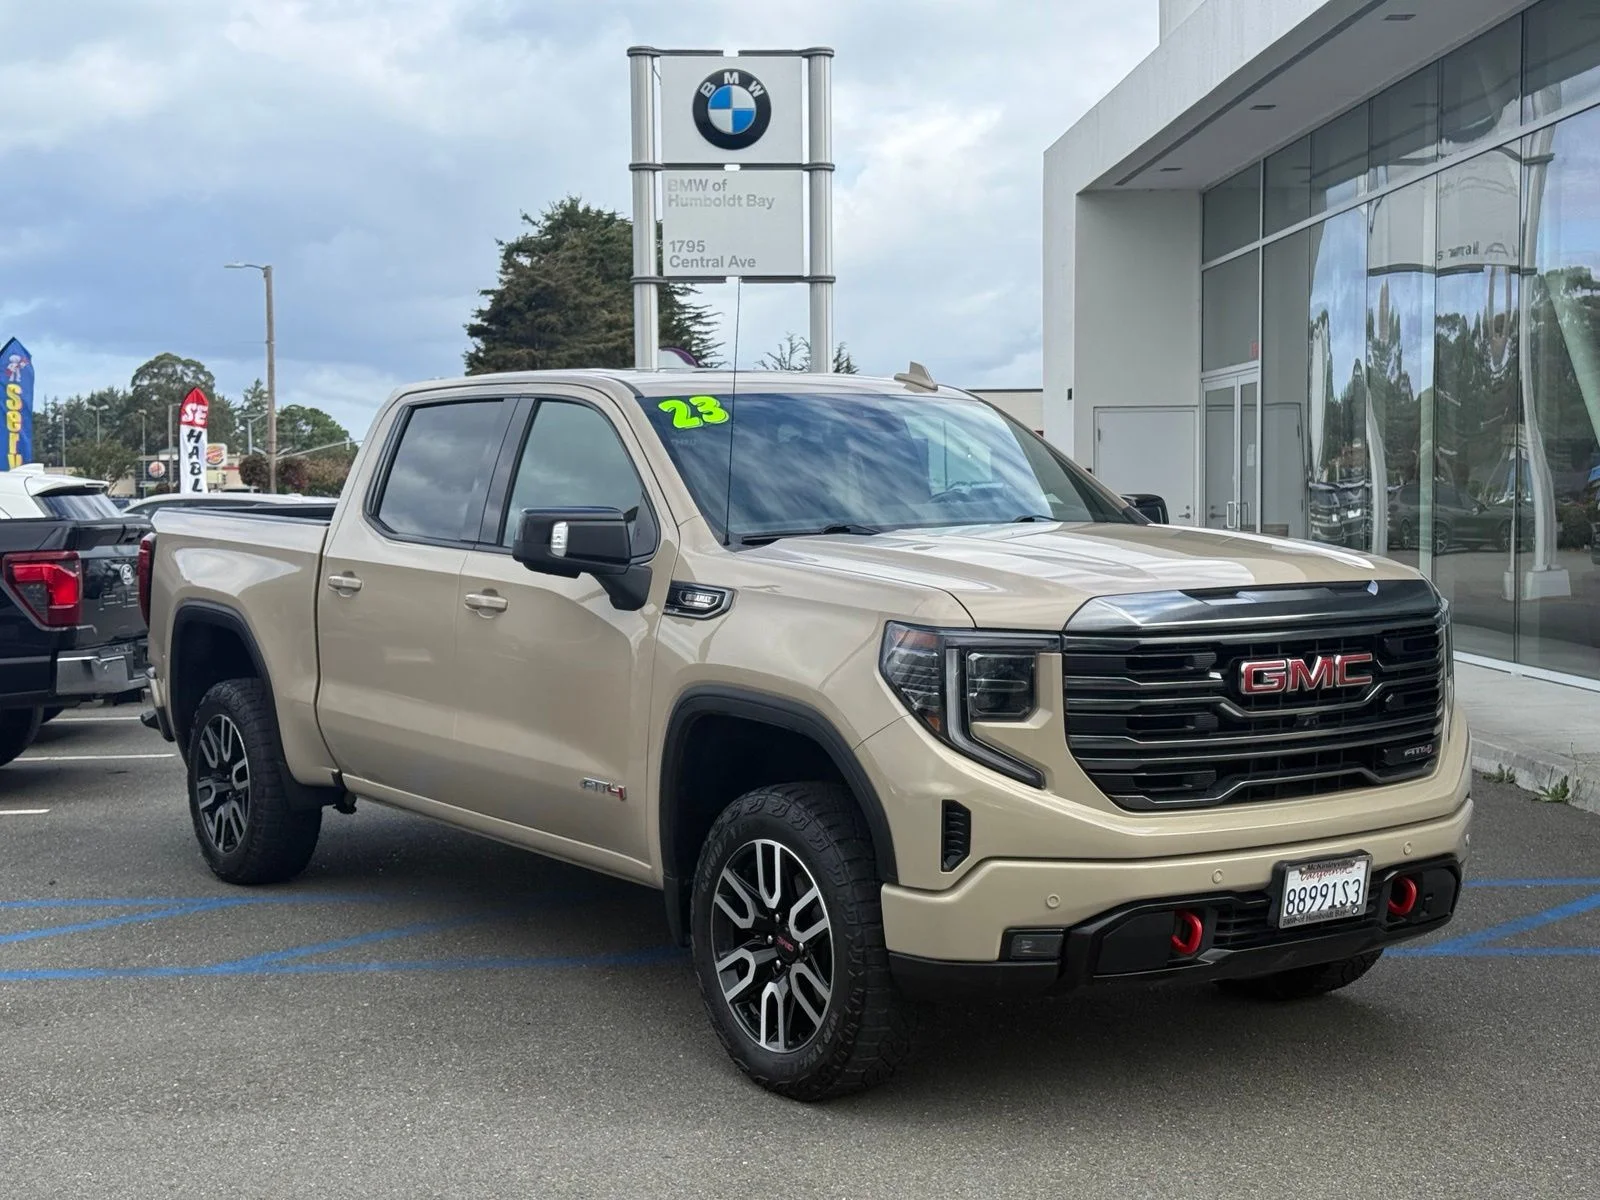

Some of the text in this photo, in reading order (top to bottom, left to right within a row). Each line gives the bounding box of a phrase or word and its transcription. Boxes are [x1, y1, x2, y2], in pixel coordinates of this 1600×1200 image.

[700, 71, 764, 98] BMW
[667, 178, 728, 192] BMW of
[667, 194, 775, 210] Humboldt Bay
[669, 240, 705, 253] 1795
[669, 255, 756, 268] Central Ave
[181, 403, 208, 425] SE
[658, 395, 729, 429] 23
[1240, 652, 1373, 695] GMC
[1286, 879, 1361, 915] 88991S3
